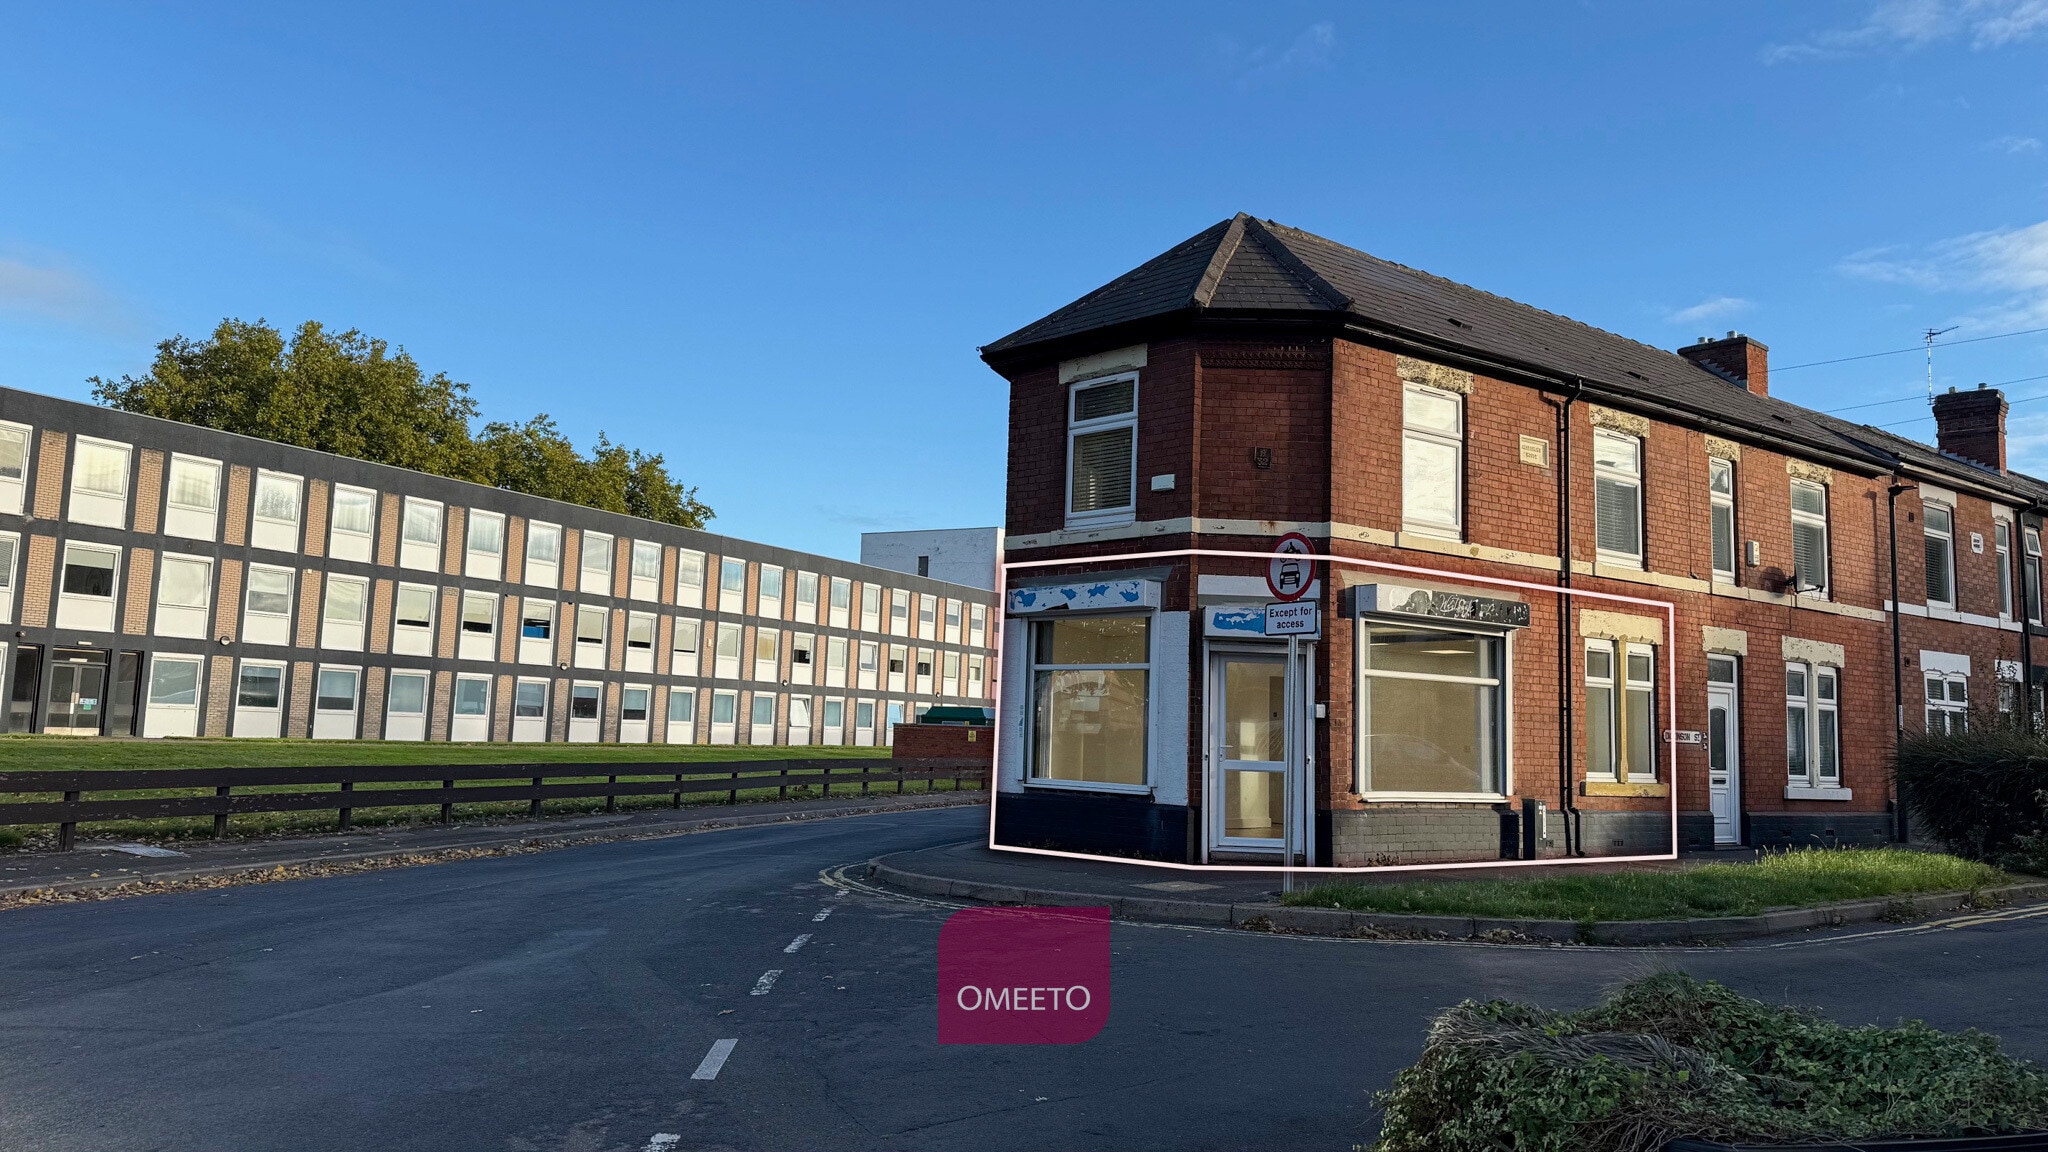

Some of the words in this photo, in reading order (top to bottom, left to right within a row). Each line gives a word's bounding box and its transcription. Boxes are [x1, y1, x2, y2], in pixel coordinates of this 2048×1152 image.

[1270, 607, 1298, 618] Except
[1300, 606, 1313, 616] for
[1276, 620, 1305, 629] access
